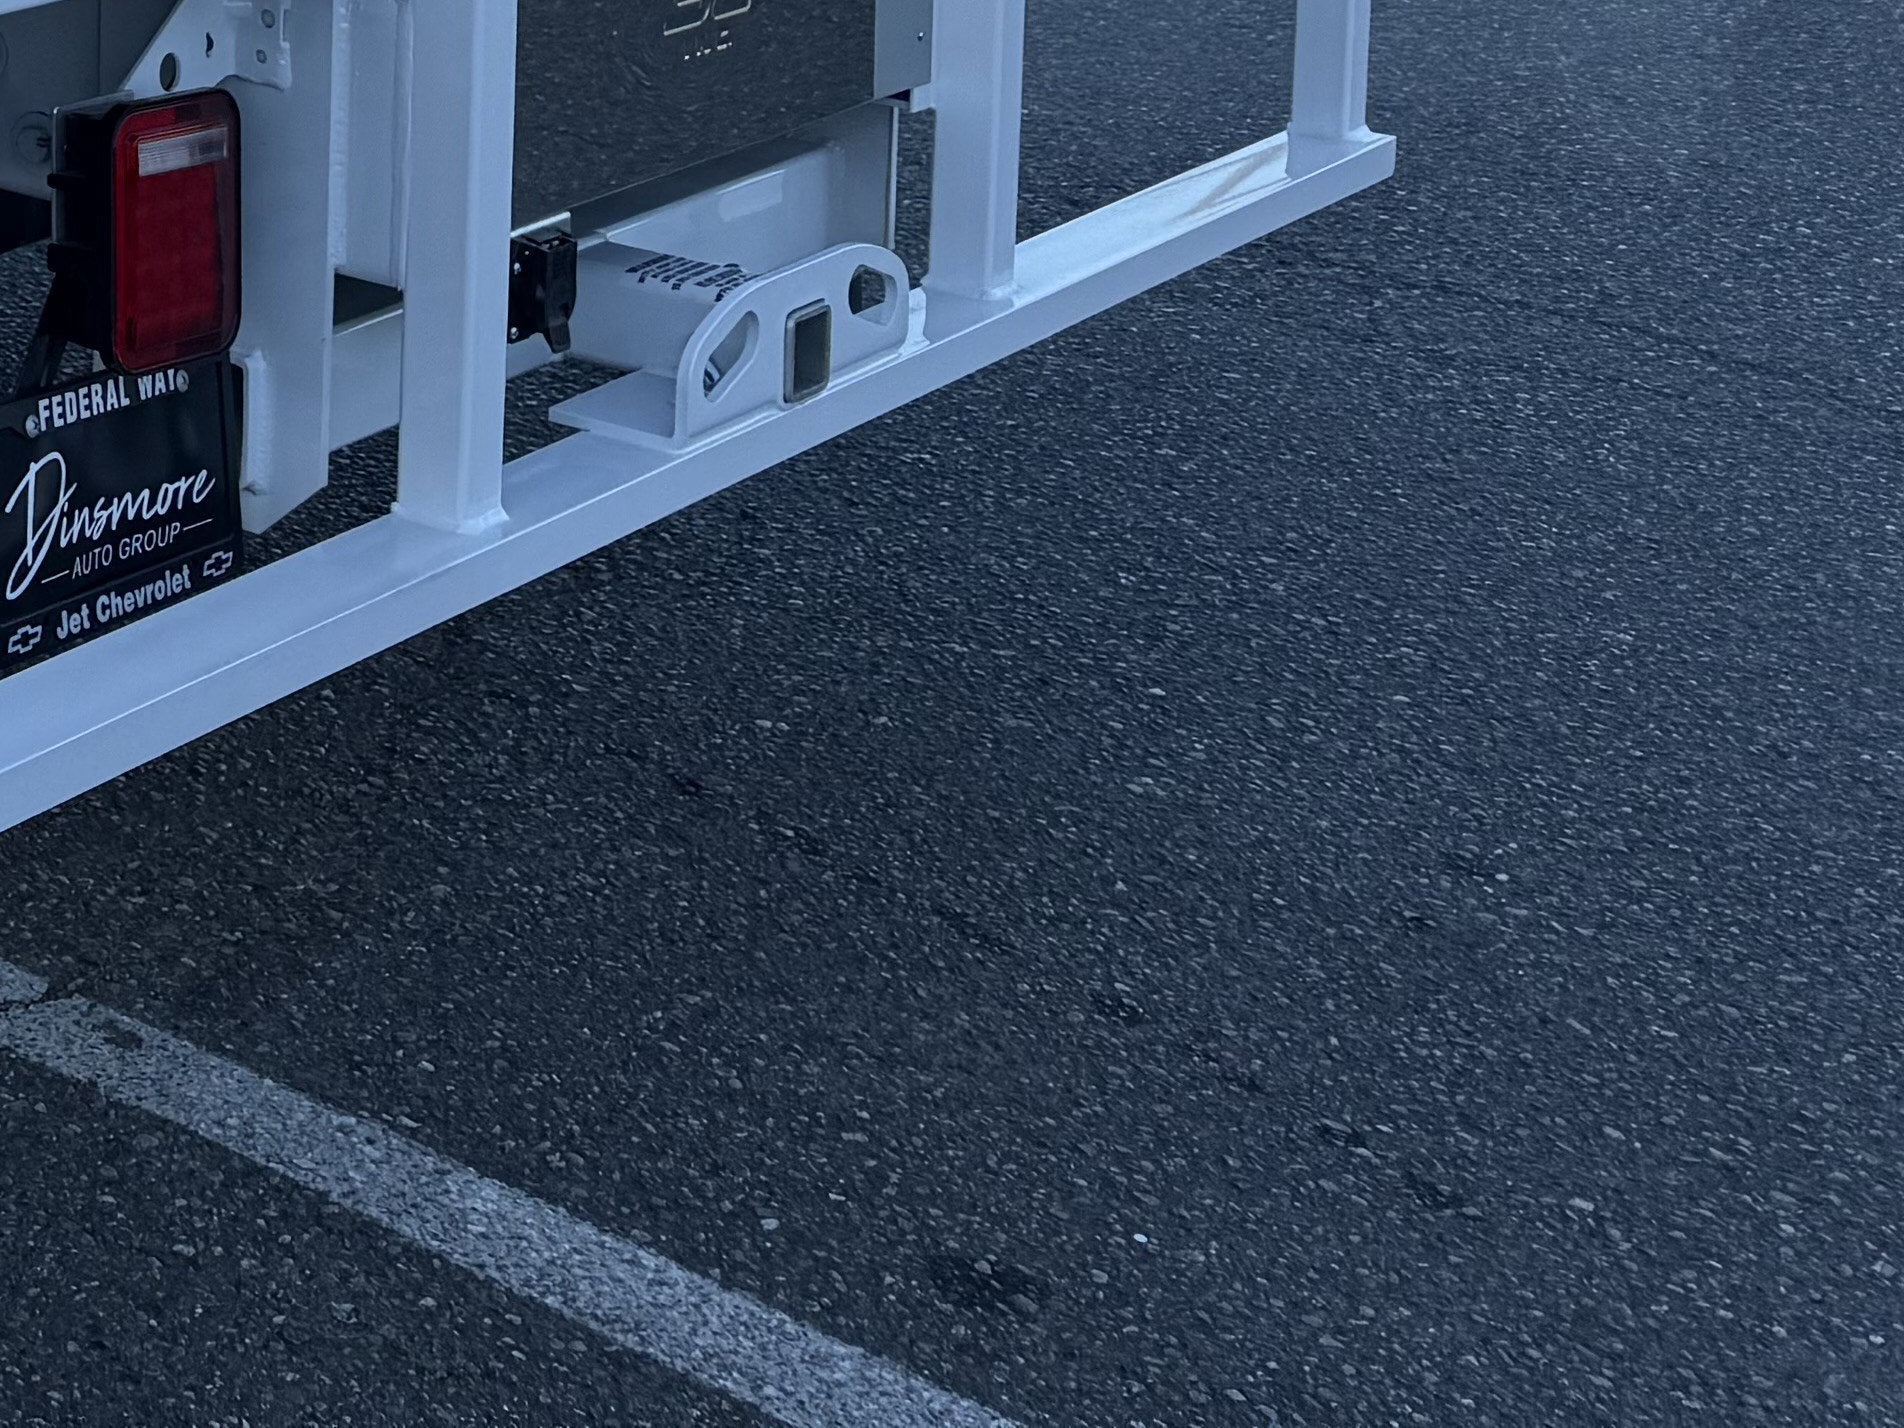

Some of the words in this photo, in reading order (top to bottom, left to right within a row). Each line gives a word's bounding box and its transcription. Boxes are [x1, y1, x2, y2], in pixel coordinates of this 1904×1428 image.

[38, 375, 130, 432] FEDERAL
[138, 368, 176, 401] WAY
[4, 450, 216, 600] Dinsmore
[72, 545, 113, 580] AUTO
[119, 523, 180, 561] GROUP
[56, 609, 90, 641] Jet
[96, 564, 192, 620] Chevrolet
